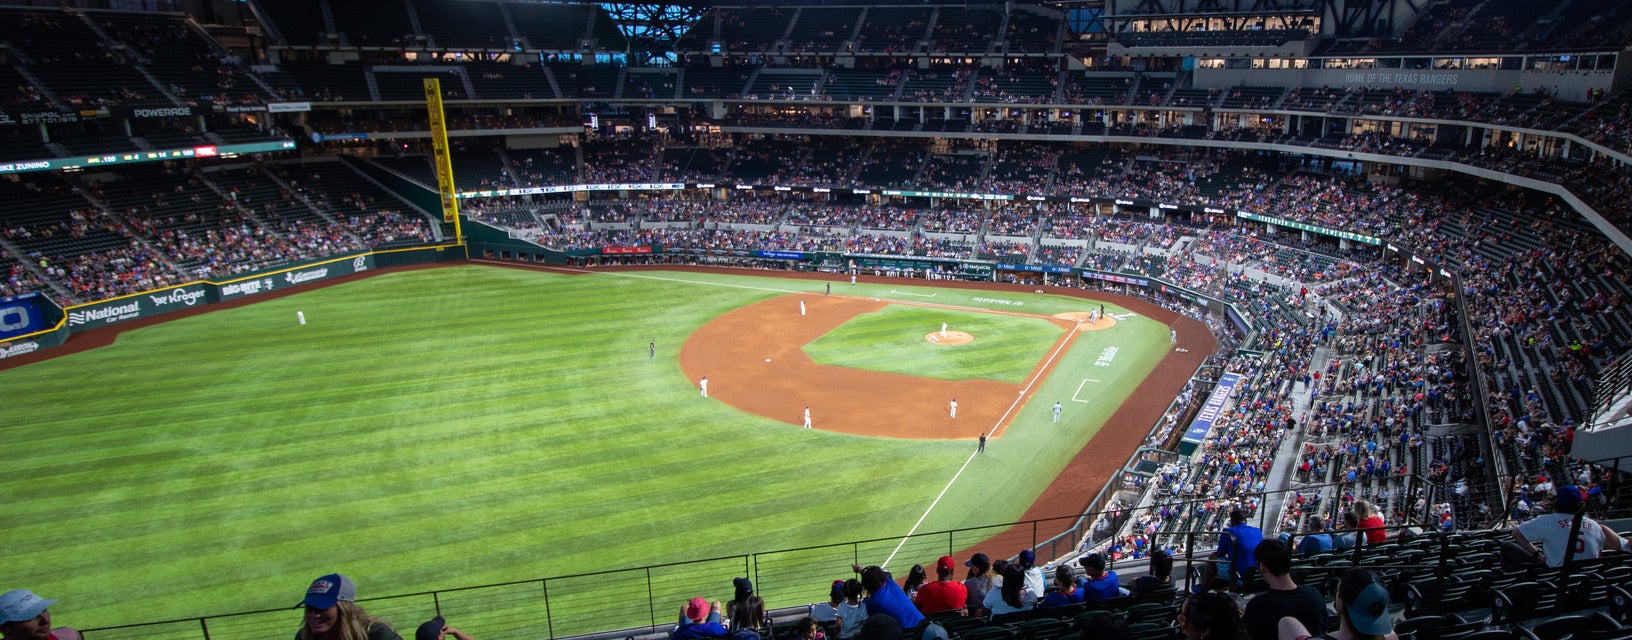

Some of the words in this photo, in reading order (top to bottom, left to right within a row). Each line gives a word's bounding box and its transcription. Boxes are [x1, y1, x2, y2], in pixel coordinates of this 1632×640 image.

[1345, 73, 1364, 83] HOME
[1367, 74, 1377, 83] OF
[1380, 74, 1392, 84] THE
[1394, 74, 1418, 84] TEXAS
[1420, 74, 1458, 84] RANGERS
[134, 108, 192, 118] POWERADE
[16, 162, 50, 170] ZUNINO
[169, 288, 205, 305] Kroger
[86, 301, 138, 321] National
[1208, 385, 1231, 406] RANGERS
[1198, 405, 1219, 422] TEXAS
[1558, 518, 1592, 531] SEER
